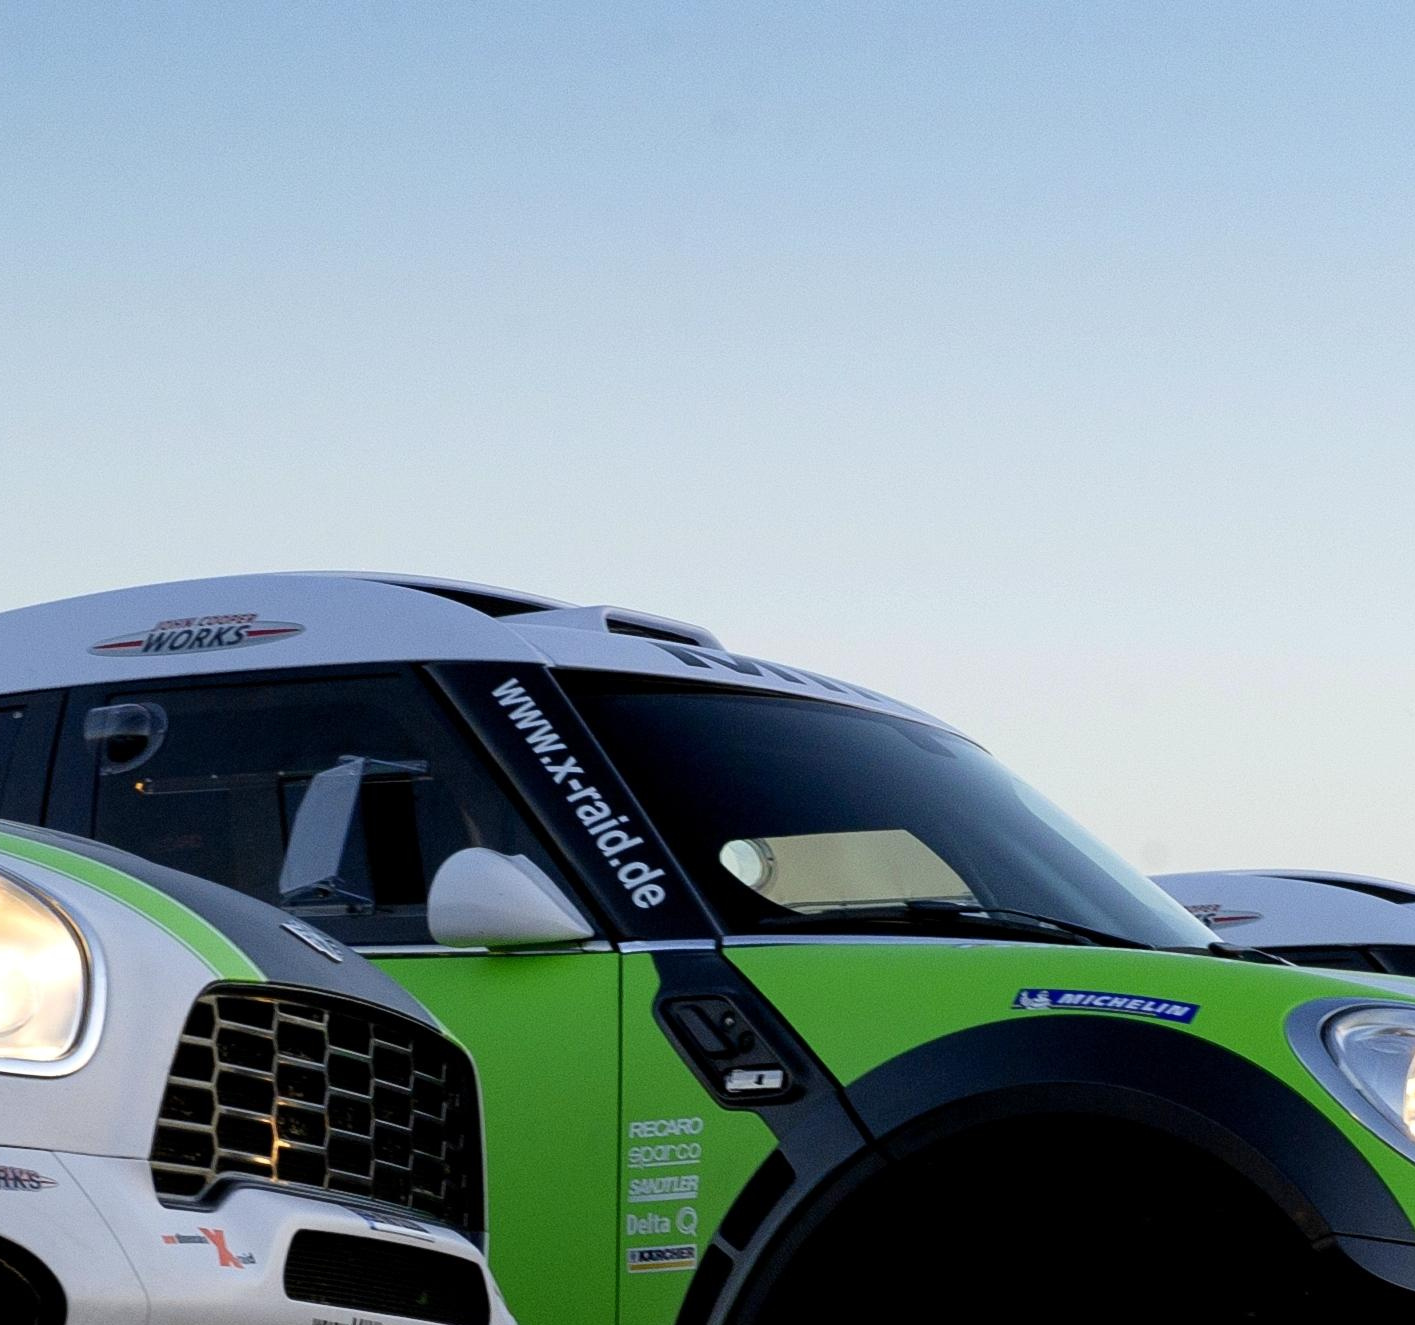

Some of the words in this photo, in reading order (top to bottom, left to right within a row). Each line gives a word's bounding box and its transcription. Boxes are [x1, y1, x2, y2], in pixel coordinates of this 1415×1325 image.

[141, 625, 251, 653] WORKS
[490, 677, 666, 909] www.x-raid.de
[1057, 993, 1191, 1018] MICHELIN
[629, 1117, 704, 1138] RECARO
[629, 1143, 702, 1169] sparco
[626, 1212, 671, 1236] Delta
[675, 1206, 697, 1237] Q
